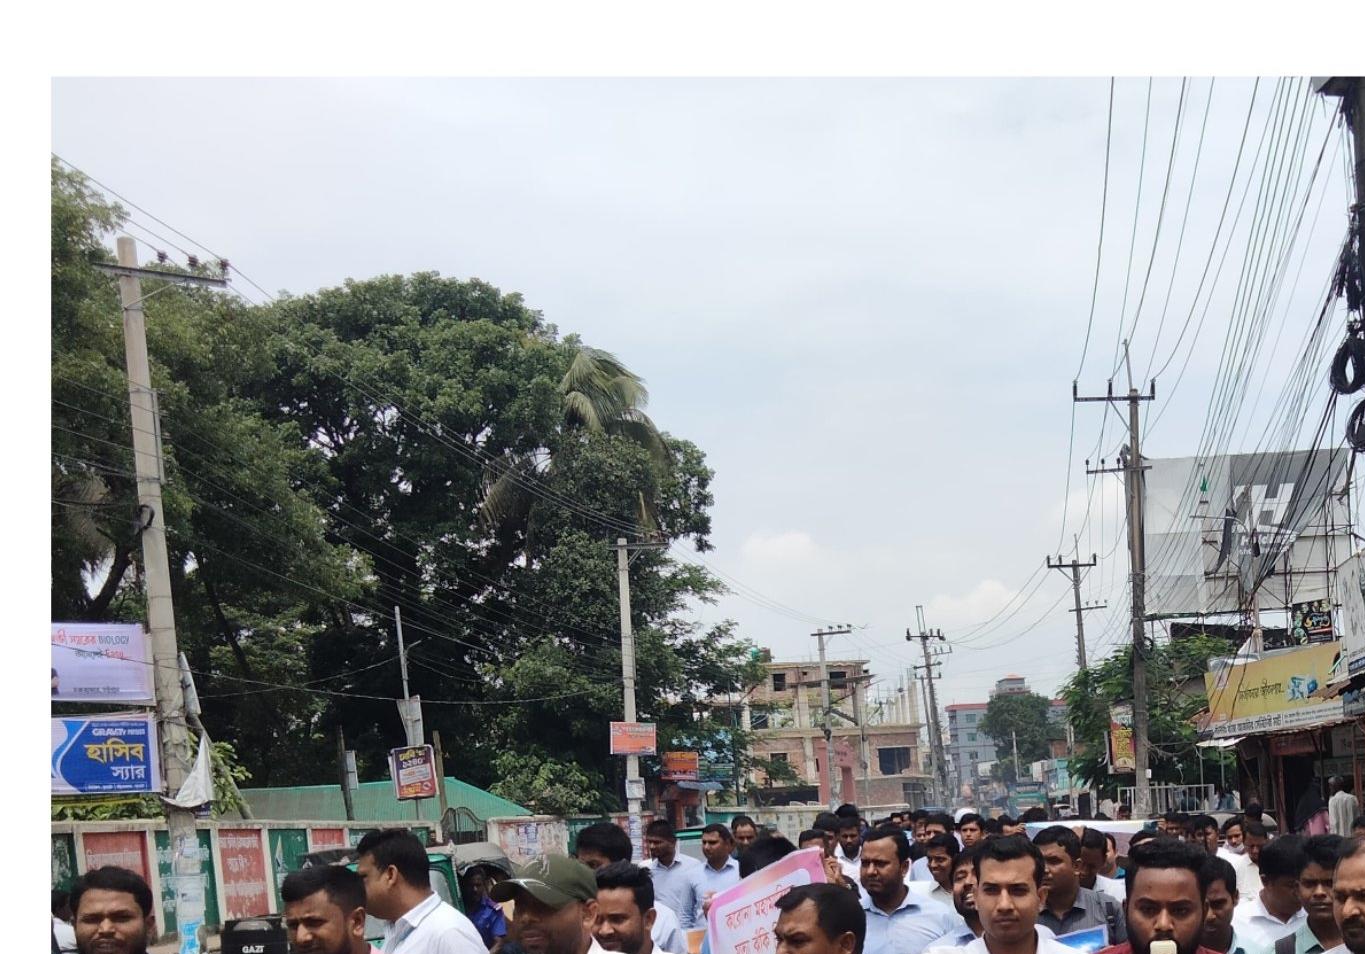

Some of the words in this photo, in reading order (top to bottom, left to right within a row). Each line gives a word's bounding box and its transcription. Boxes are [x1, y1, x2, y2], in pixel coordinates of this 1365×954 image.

[84, 737, 145, 764] হাসিব
[111, 765, 146, 780] স্যার
[242, 945, 264, 954] GAZI
